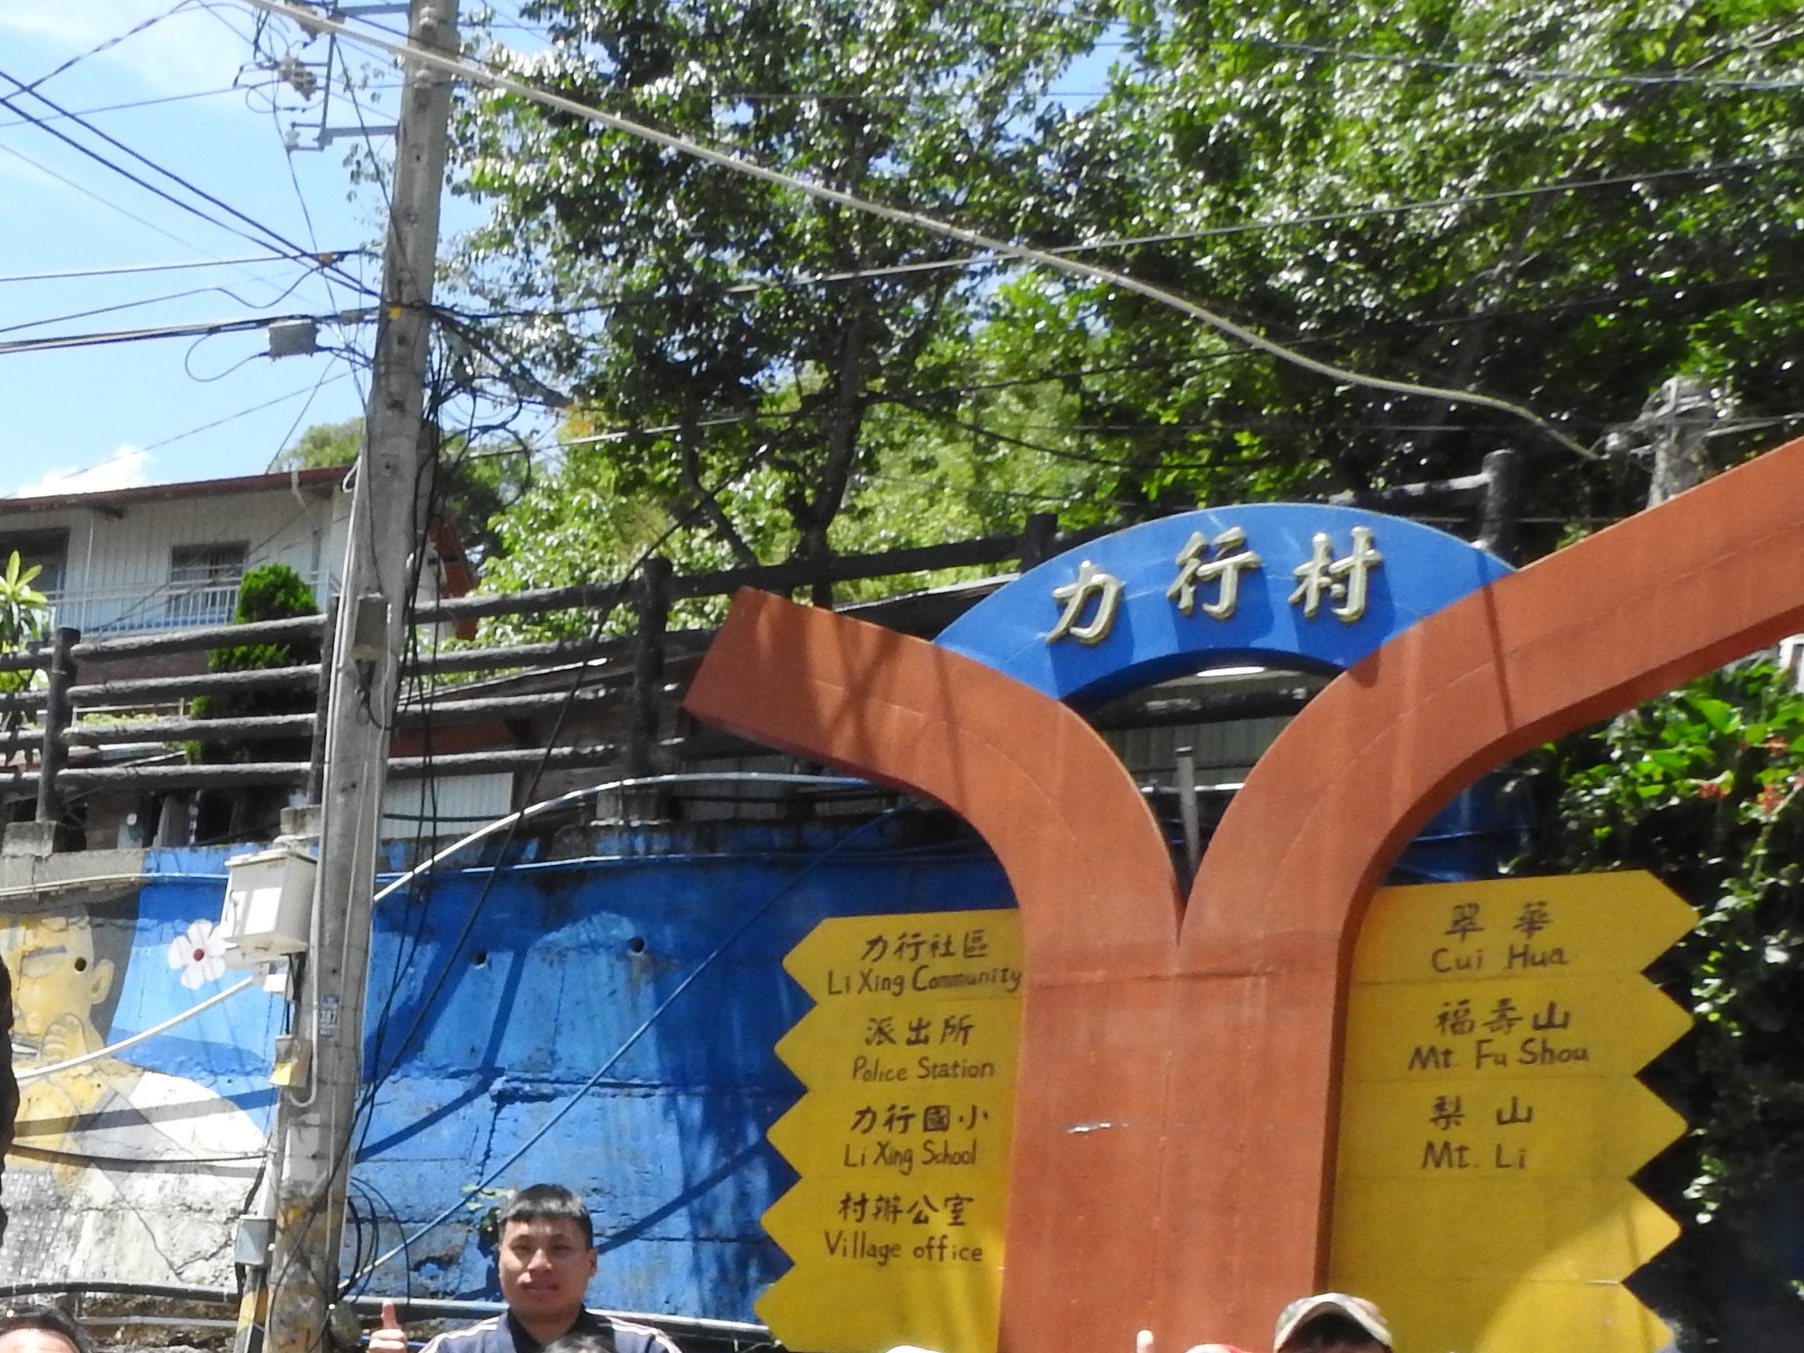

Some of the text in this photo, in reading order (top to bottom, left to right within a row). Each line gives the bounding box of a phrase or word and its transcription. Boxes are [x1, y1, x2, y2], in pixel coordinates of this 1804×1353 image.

[1046, 526, 1383, 646] 力行村
[1445, 901, 1553, 942] 翠華
[860, 929, 988, 962] 力行社區
[1431, 944, 1569, 973] Cui Hua
[827, 964, 1023, 997] Li Xing Community
[864, 1014, 975, 1047] 派出所
[1436, 998, 1571, 1036] 福壽山
[852, 1055, 995, 1083] Police Station
[1475, 1038, 1508, 1070] Fu
[1519, 1037, 1590, 1065] Shou
[850, 1103, 989, 1135] 力行國小
[1430, 1095, 1534, 1131] 梨山
[844, 1139, 977, 1176] Li Xing School
[1422, 1140, 1527, 1170] Mt. Li
[824, 1230, 983, 1267] Village office
